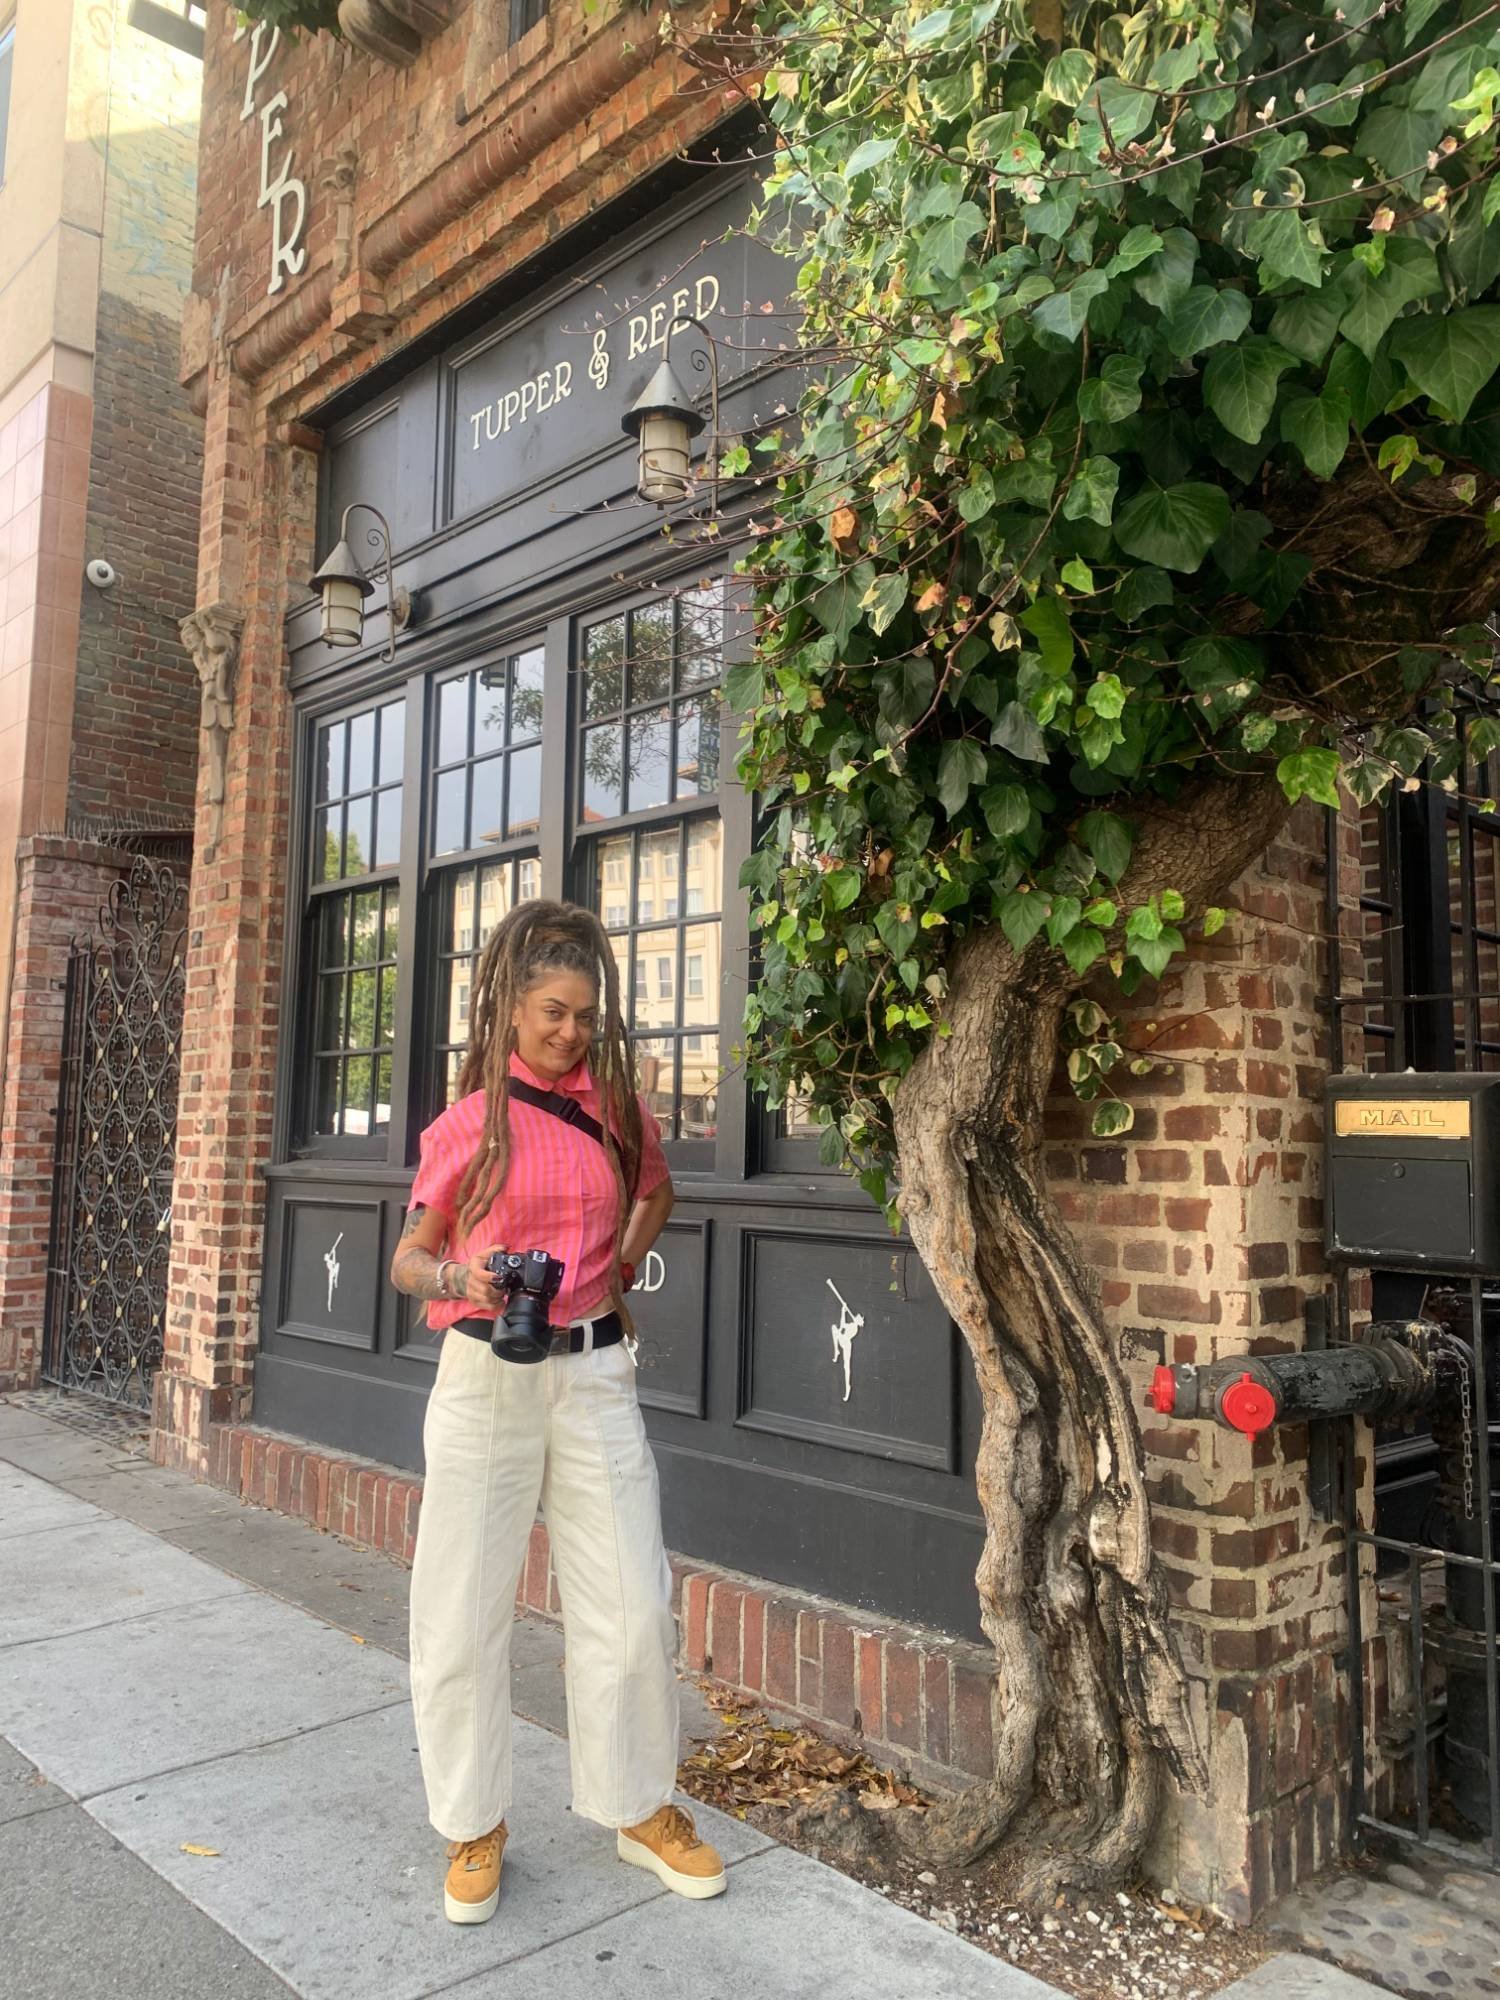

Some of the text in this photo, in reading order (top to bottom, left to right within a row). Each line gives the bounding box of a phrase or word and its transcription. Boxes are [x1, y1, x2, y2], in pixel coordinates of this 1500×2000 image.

[233, 19, 305, 294] PER
[470, 275, 719, 450] TUPPER & REED
[1360, 1109, 1445, 1126] MAIL
